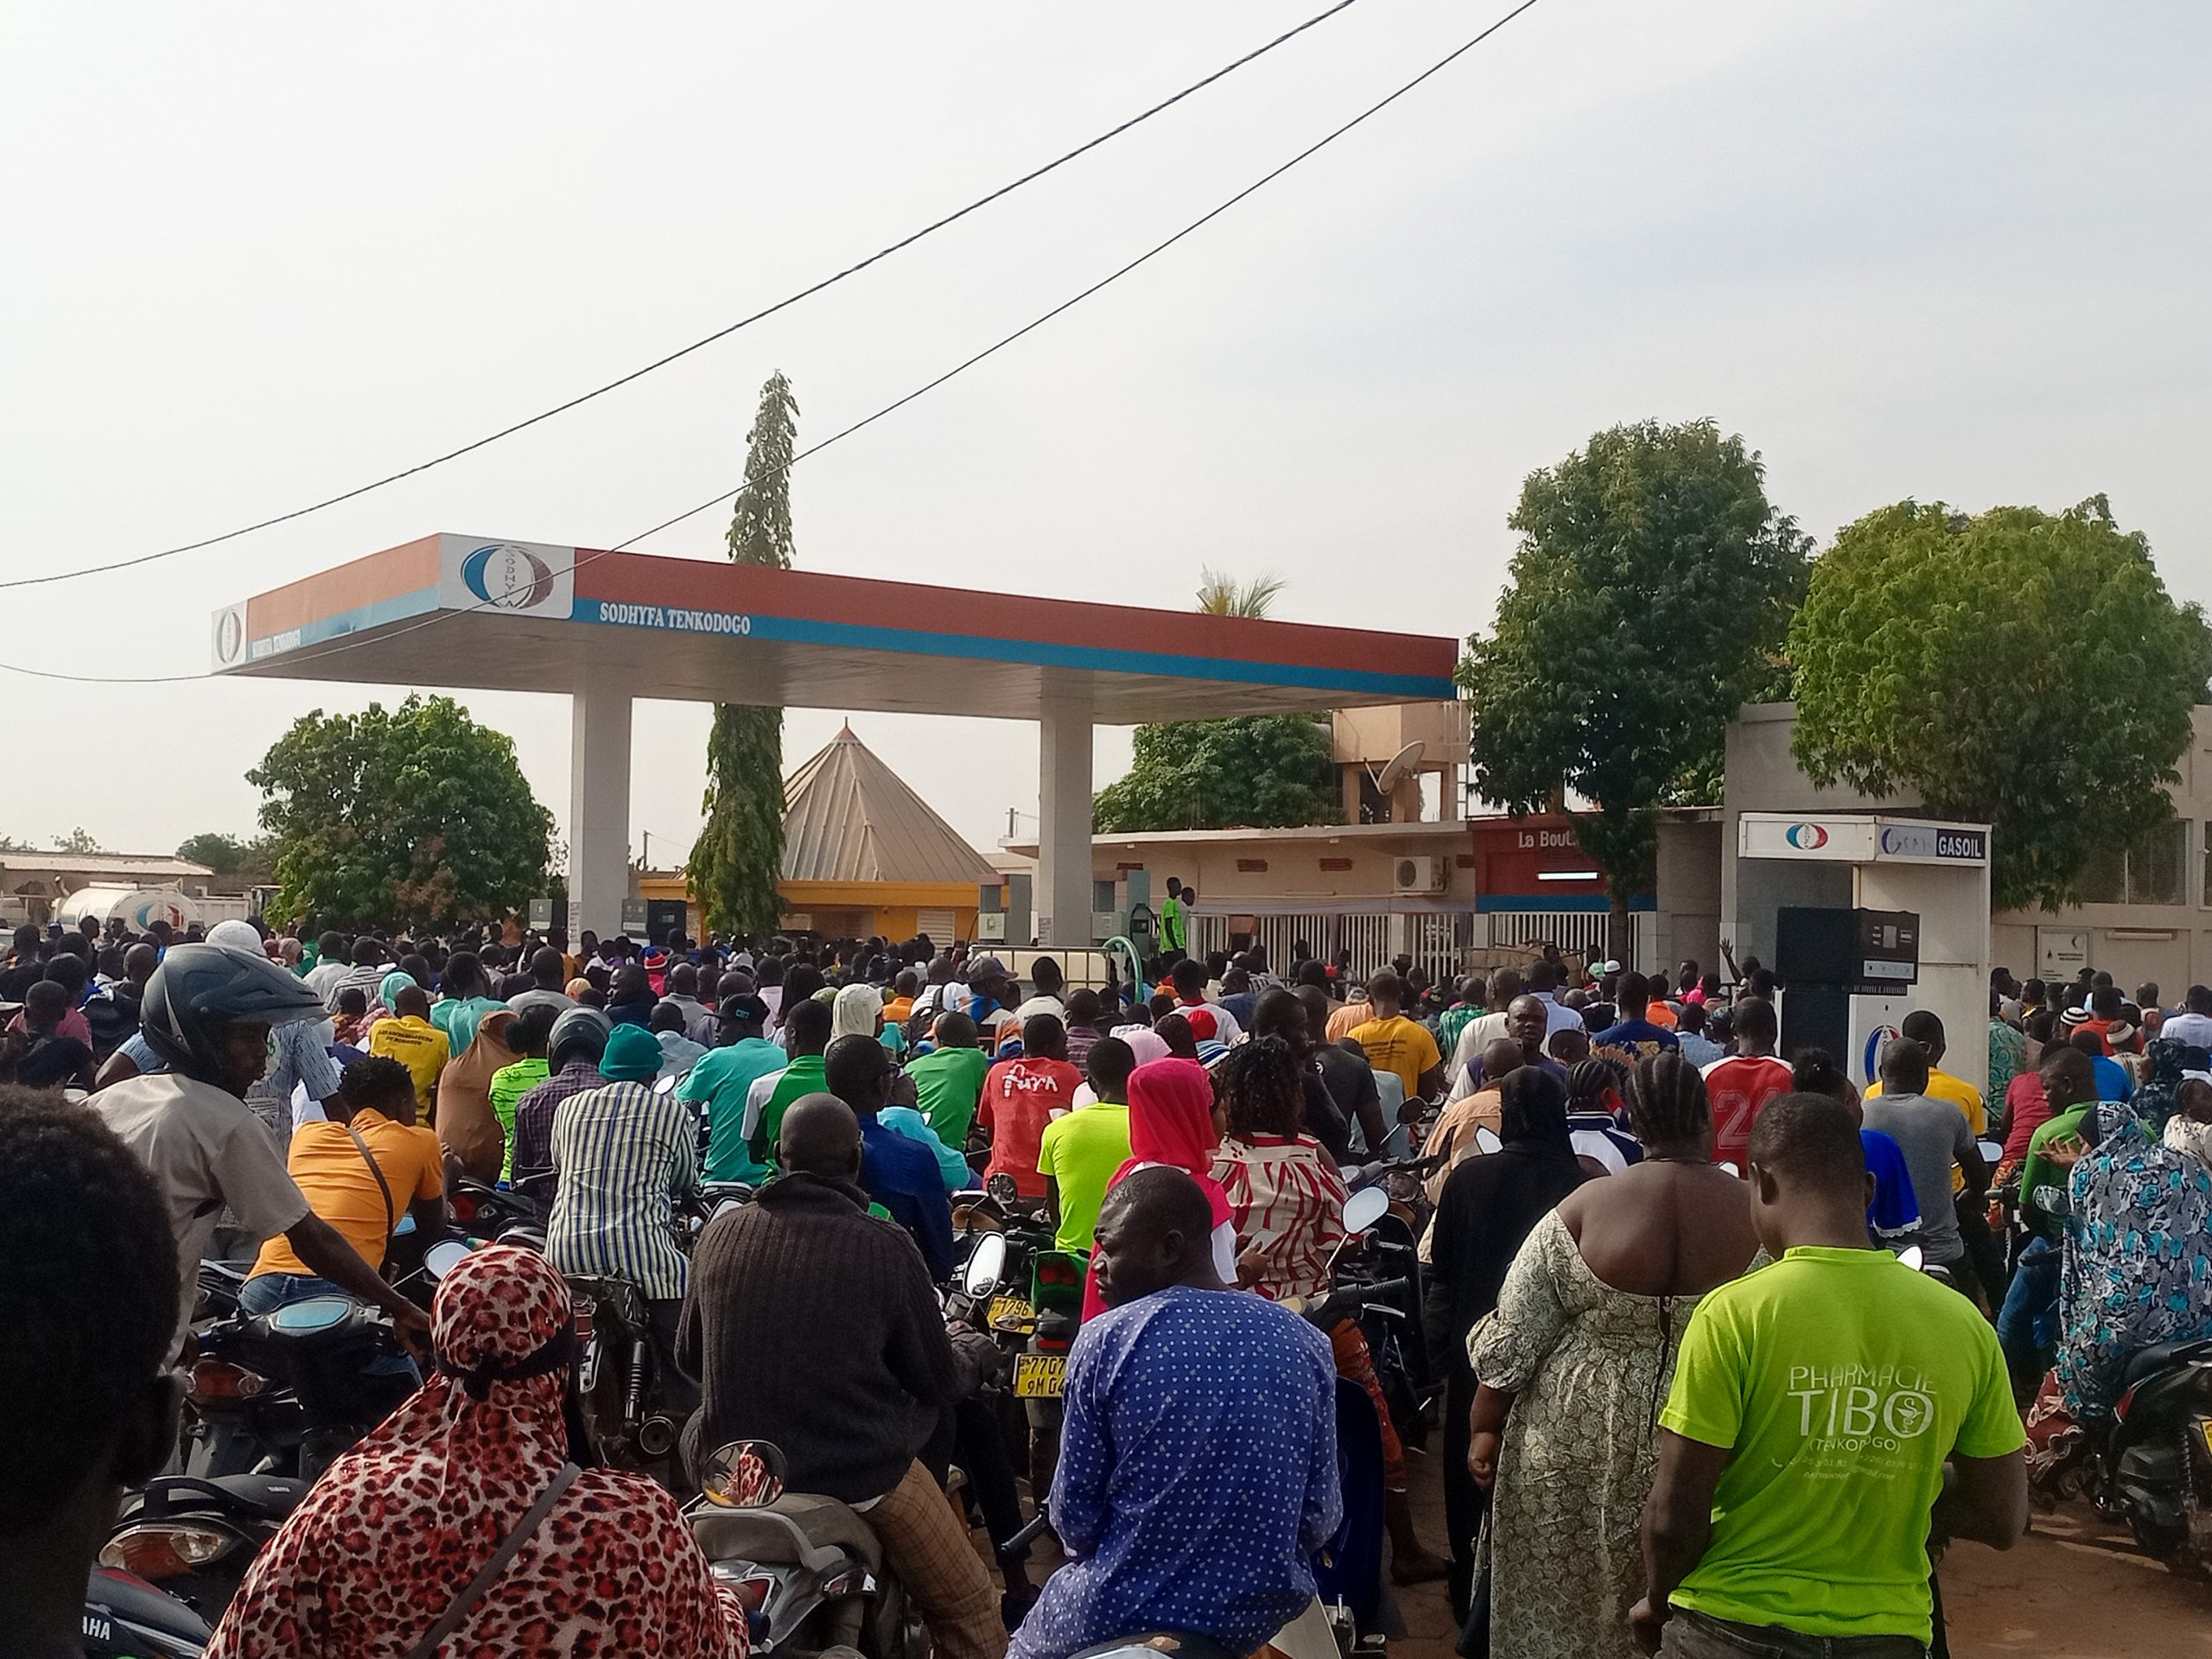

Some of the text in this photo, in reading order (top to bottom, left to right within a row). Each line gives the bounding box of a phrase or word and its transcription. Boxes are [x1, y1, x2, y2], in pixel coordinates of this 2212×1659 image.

[600, 602, 751, 635] SODHYFA TENKODOGO
[1519, 830, 1580, 848] La Bout
[1938, 836, 1981, 857] GASOIL
[1789, 1363, 1937, 1395] PHARMACIE
[1786, 1386, 1935, 1439] TIBO
